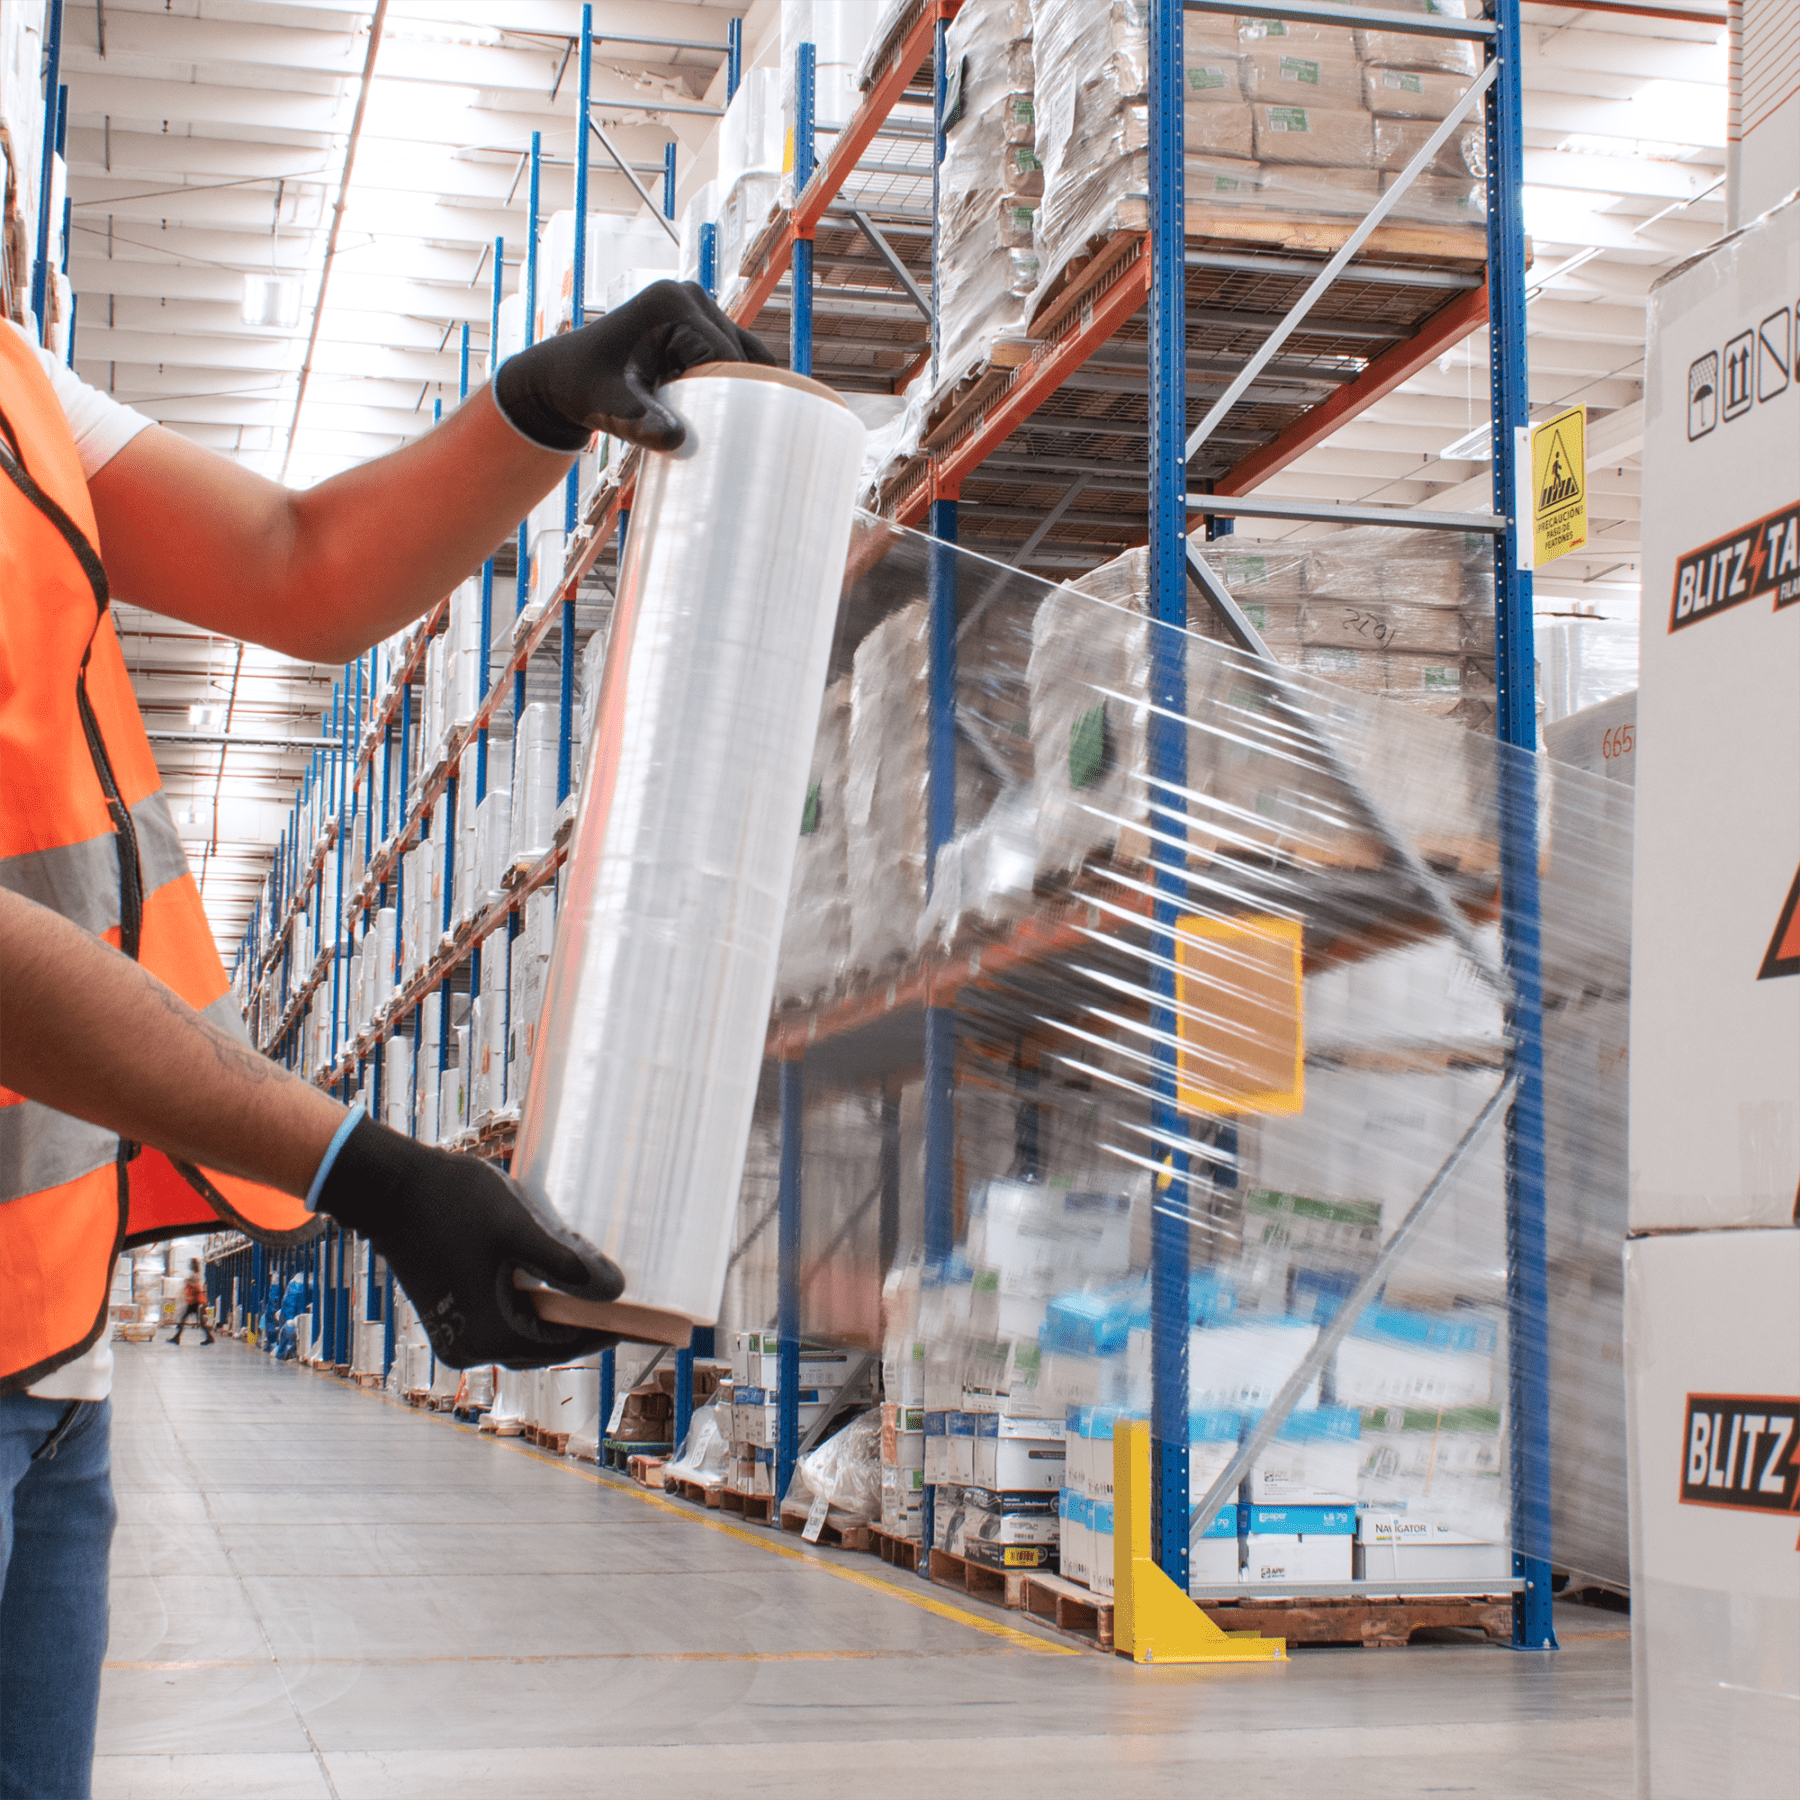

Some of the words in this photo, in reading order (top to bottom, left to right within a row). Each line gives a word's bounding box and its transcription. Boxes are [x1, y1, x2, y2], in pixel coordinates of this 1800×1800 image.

[1675, 538, 1751, 620] BLITZ
[1767, 515, 1800, 580] TA
[1602, 724, 1636, 760] 665
[1686, 1411, 1796, 1495] BLITZ
